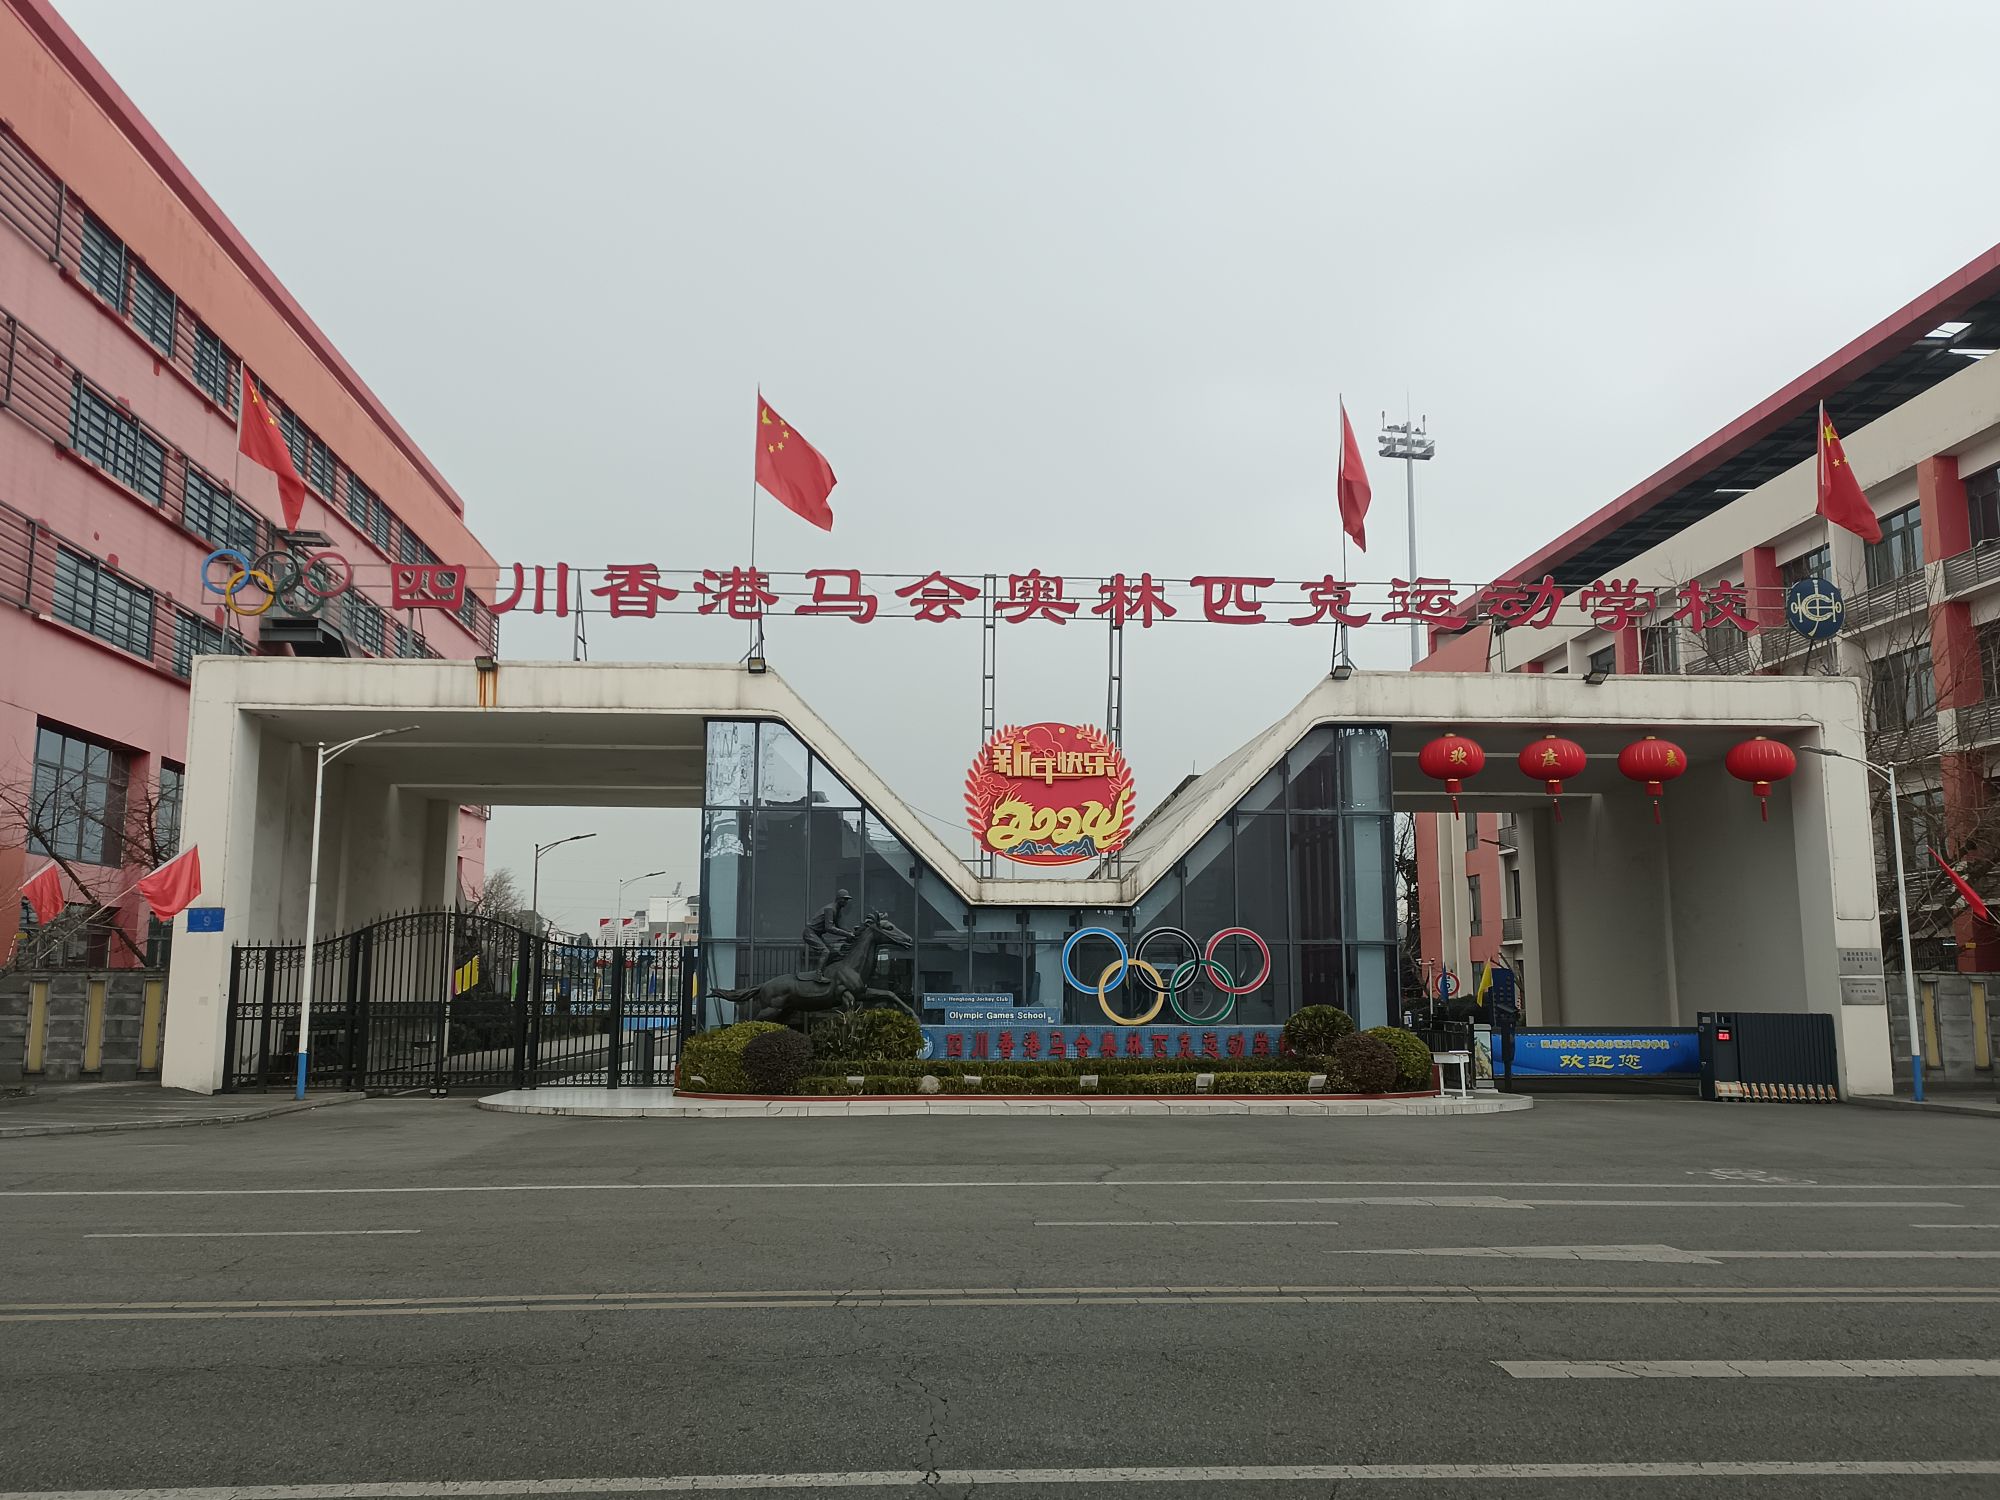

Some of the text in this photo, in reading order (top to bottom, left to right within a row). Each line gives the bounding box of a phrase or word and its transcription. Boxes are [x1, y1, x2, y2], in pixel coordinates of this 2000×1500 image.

[390, 561, 1760, 632] 四川香港马会奥林匹克运动学校
[992, 742, 1116, 785] 新年快乐
[1450, 746, 1680, 767] 欢 度 春
[986, 786, 1131, 850] 2024
[203, 915, 211, 927] 9
[949, 1011, 984, 1020] Olympic
[1017, 1011, 1046, 1019] School
[1560, 1054, 1643, 1069] 欢迎您
